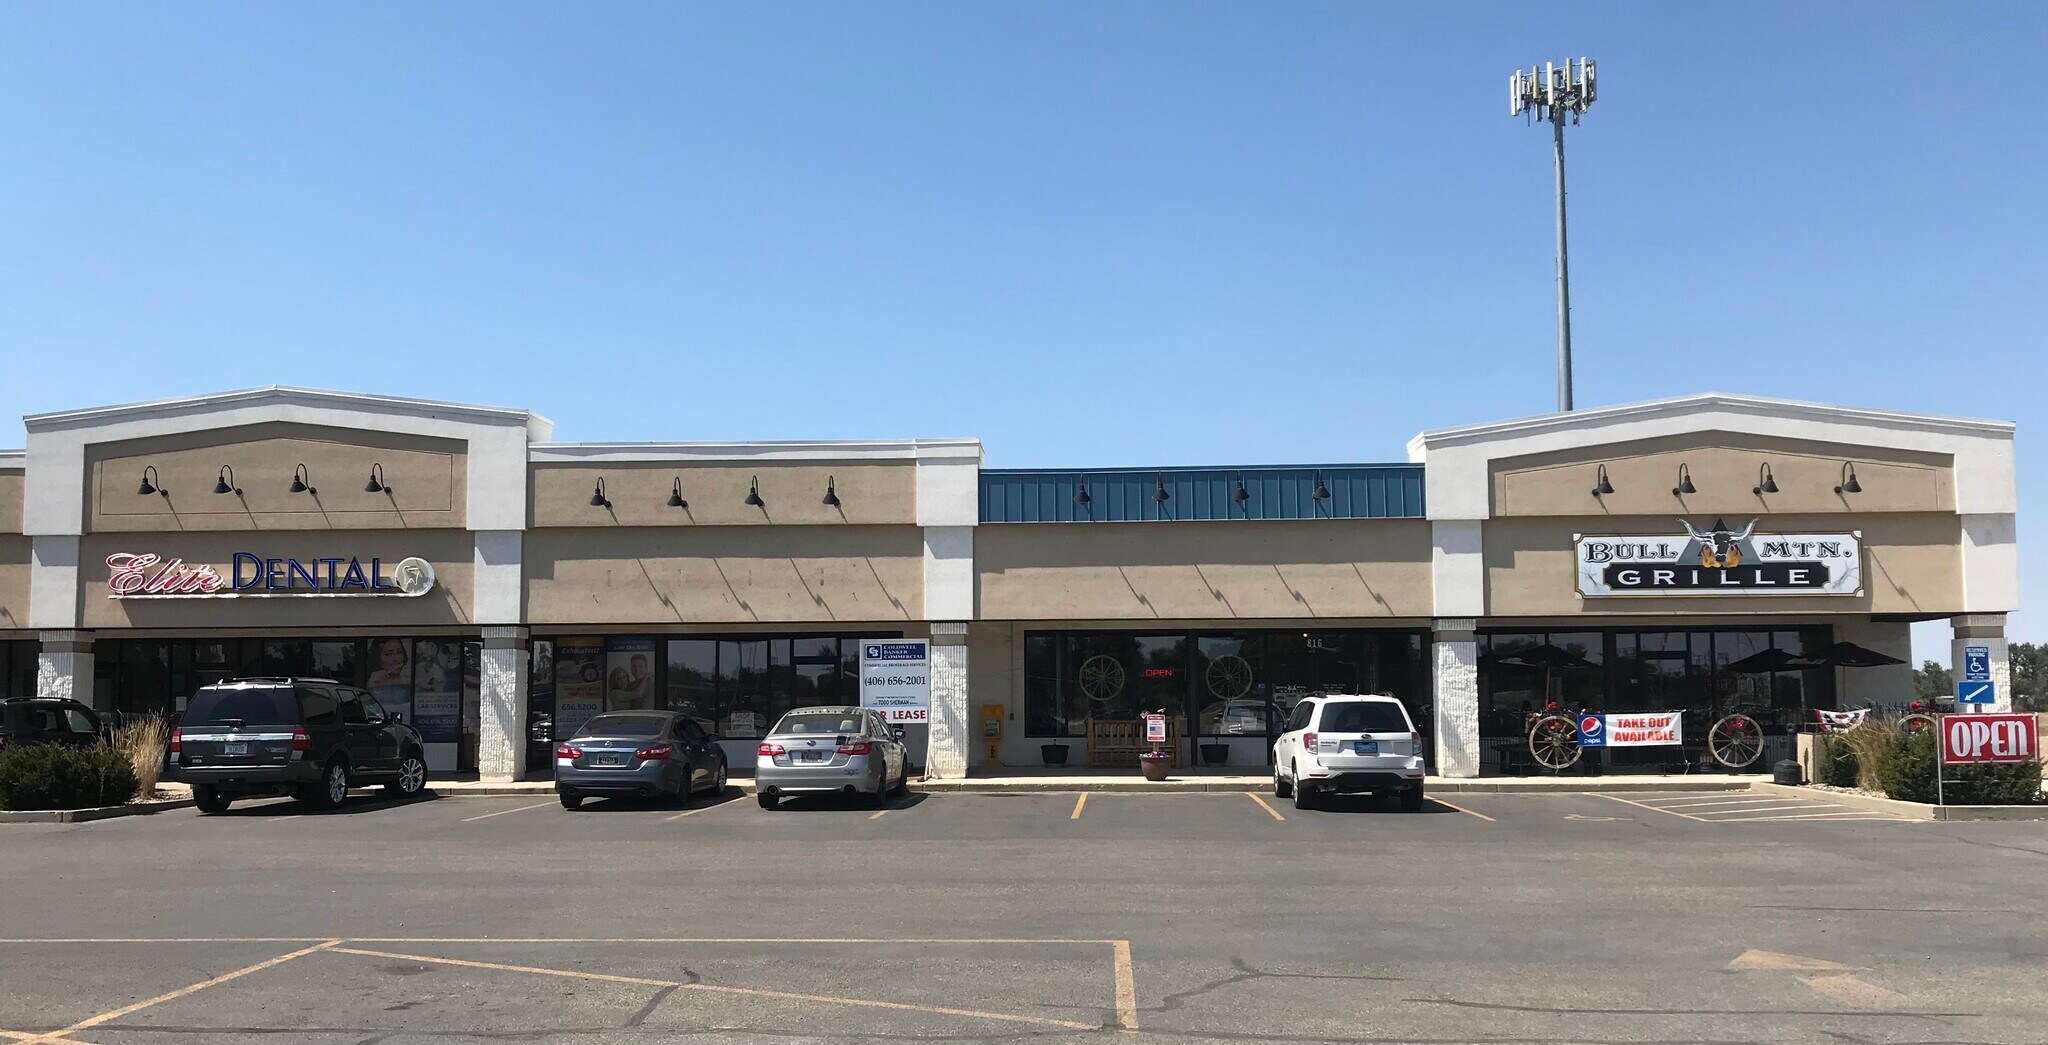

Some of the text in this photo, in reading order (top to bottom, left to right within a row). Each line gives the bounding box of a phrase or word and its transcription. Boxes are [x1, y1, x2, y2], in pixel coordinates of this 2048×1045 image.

[1583, 541, 1853, 564] BULL MTN.
[104, 552, 392, 596] Elite DENTAL
[1616, 568, 1811, 586] GRILLE
[1306, 639, 1323, 648] 816
[1145, 669, 1173, 677] OPEN
[864, 675, 926, 687] (406) 656-2001
[892, 710, 926, 720] LEASE
[1616, 717, 1671, 729] TAKE OUT
[1614, 730, 1675, 742] AVAILABLE
[1950, 720, 2029, 757] OPEN
